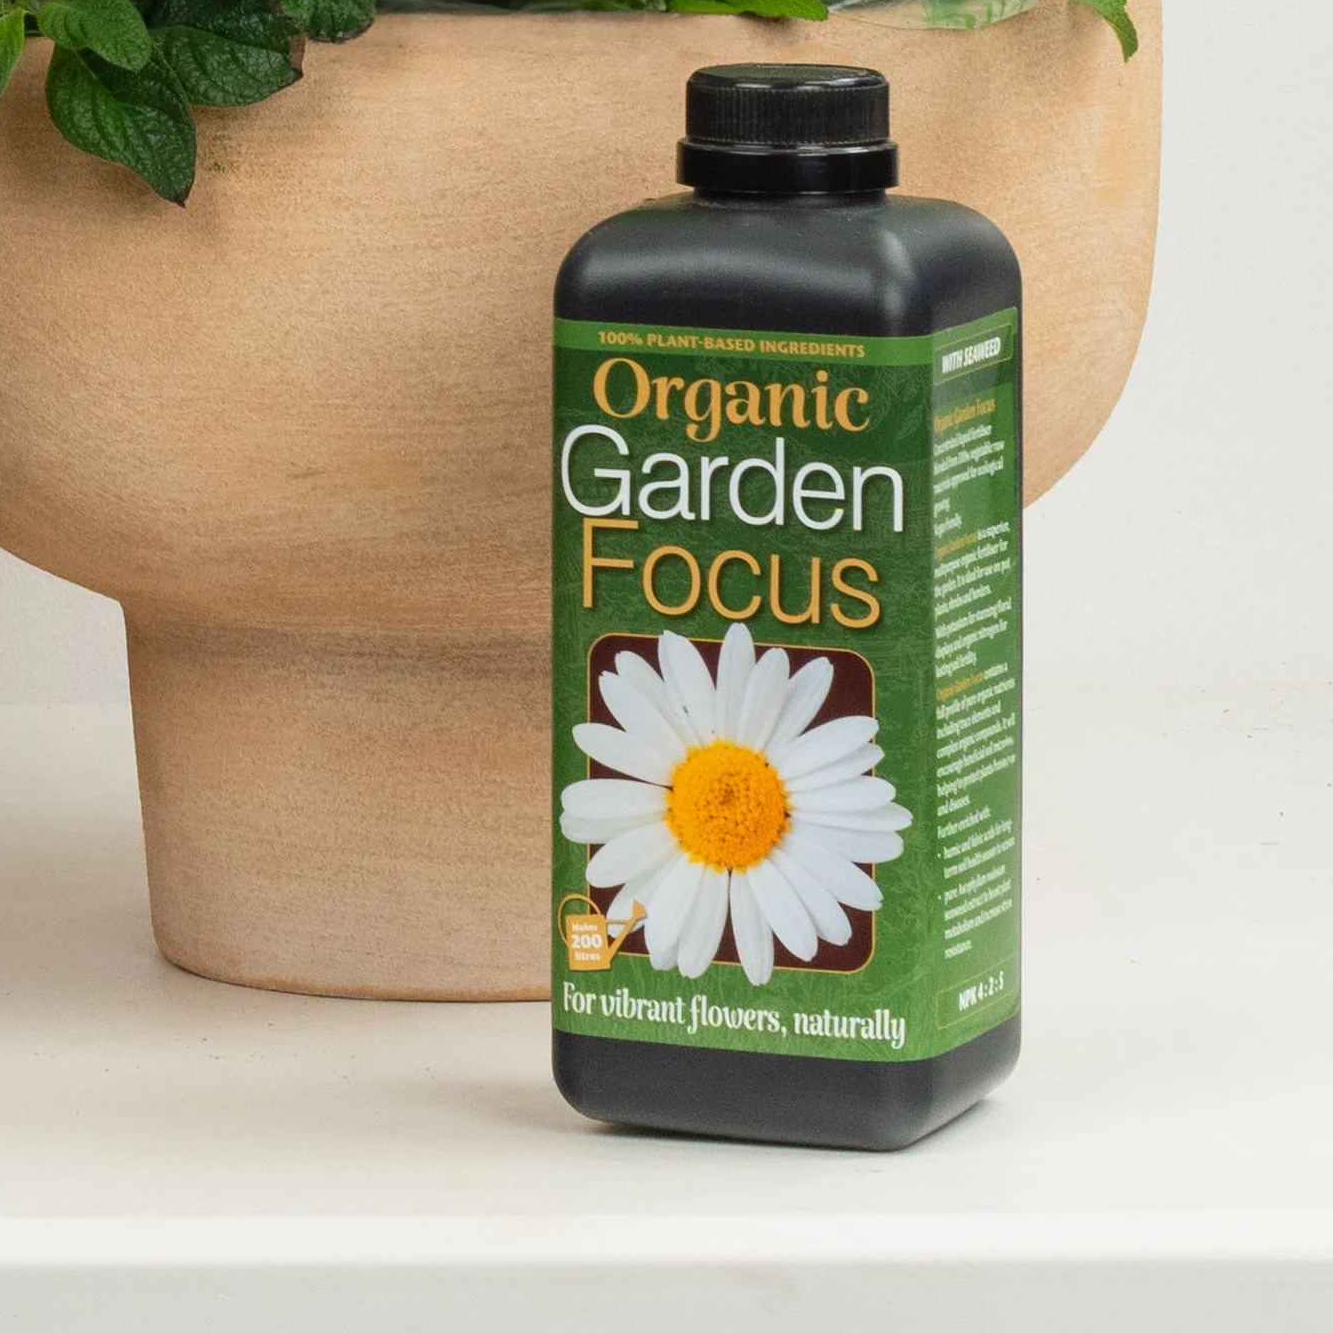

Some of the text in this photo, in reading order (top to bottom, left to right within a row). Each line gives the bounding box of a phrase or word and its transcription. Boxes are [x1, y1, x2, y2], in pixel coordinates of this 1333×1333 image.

[598, 331, 865, 359] 100% PLANT-BASED INGREDIENTS
[941, 336, 1002, 374] WITH SEAWEED
[593, 357, 871, 443] Organic
[561, 424, 904, 533] Garden
[571, 933, 603, 949] 200
[562, 981, 907, 1051] For vibrant flowers, naturally
[958, 985, 977, 1012] NPK
